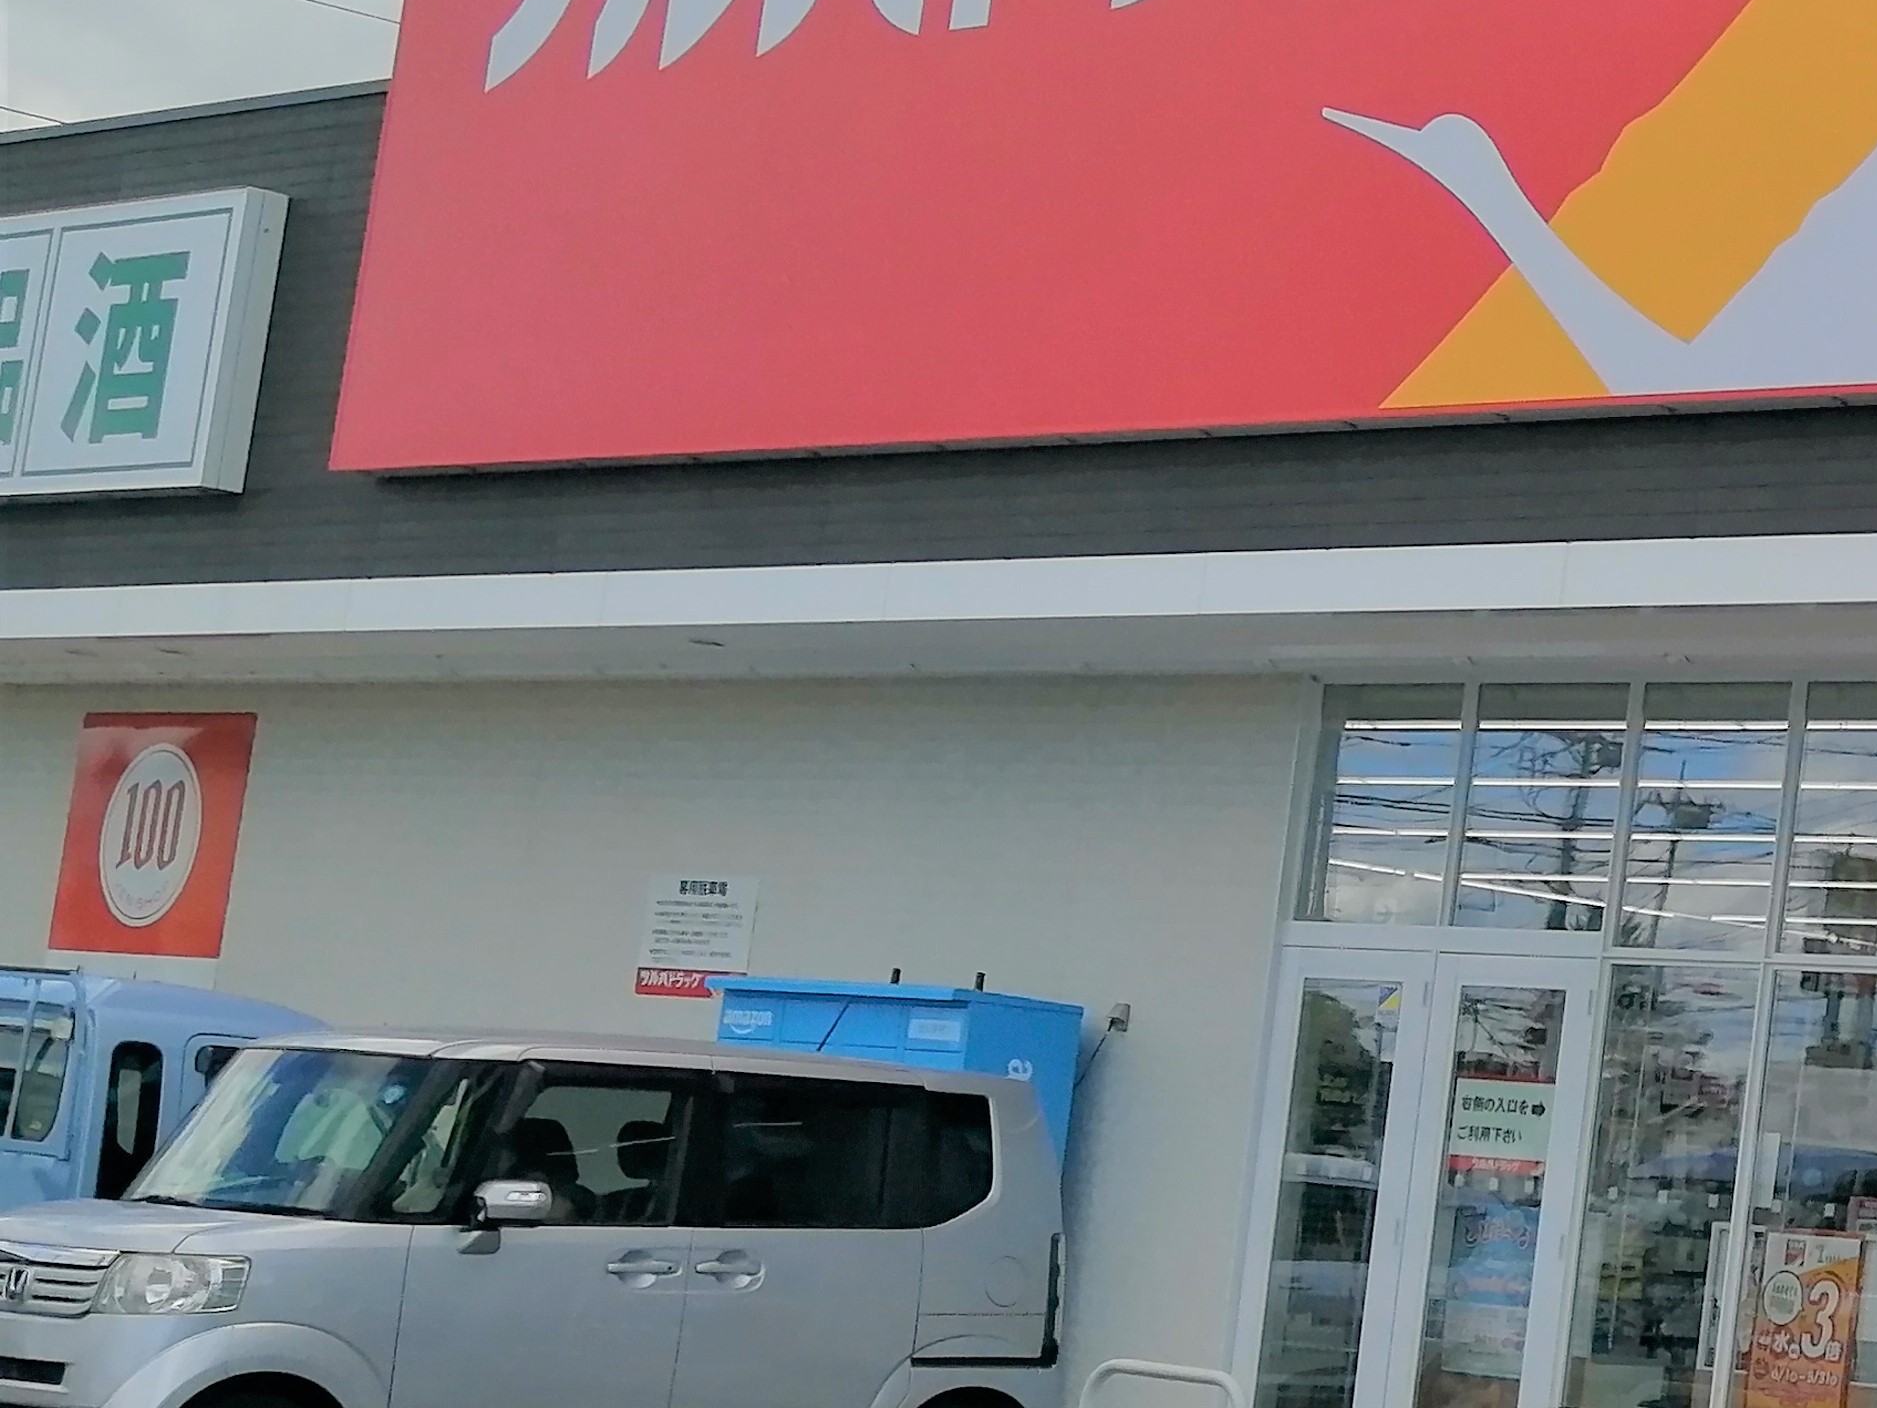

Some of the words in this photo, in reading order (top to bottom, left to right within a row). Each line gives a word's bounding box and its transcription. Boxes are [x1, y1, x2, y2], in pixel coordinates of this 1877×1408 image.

[61, 251, 191, 444] 酒
[116, 779, 185, 870] 100
[724, 1009, 773, 1026] amazon
